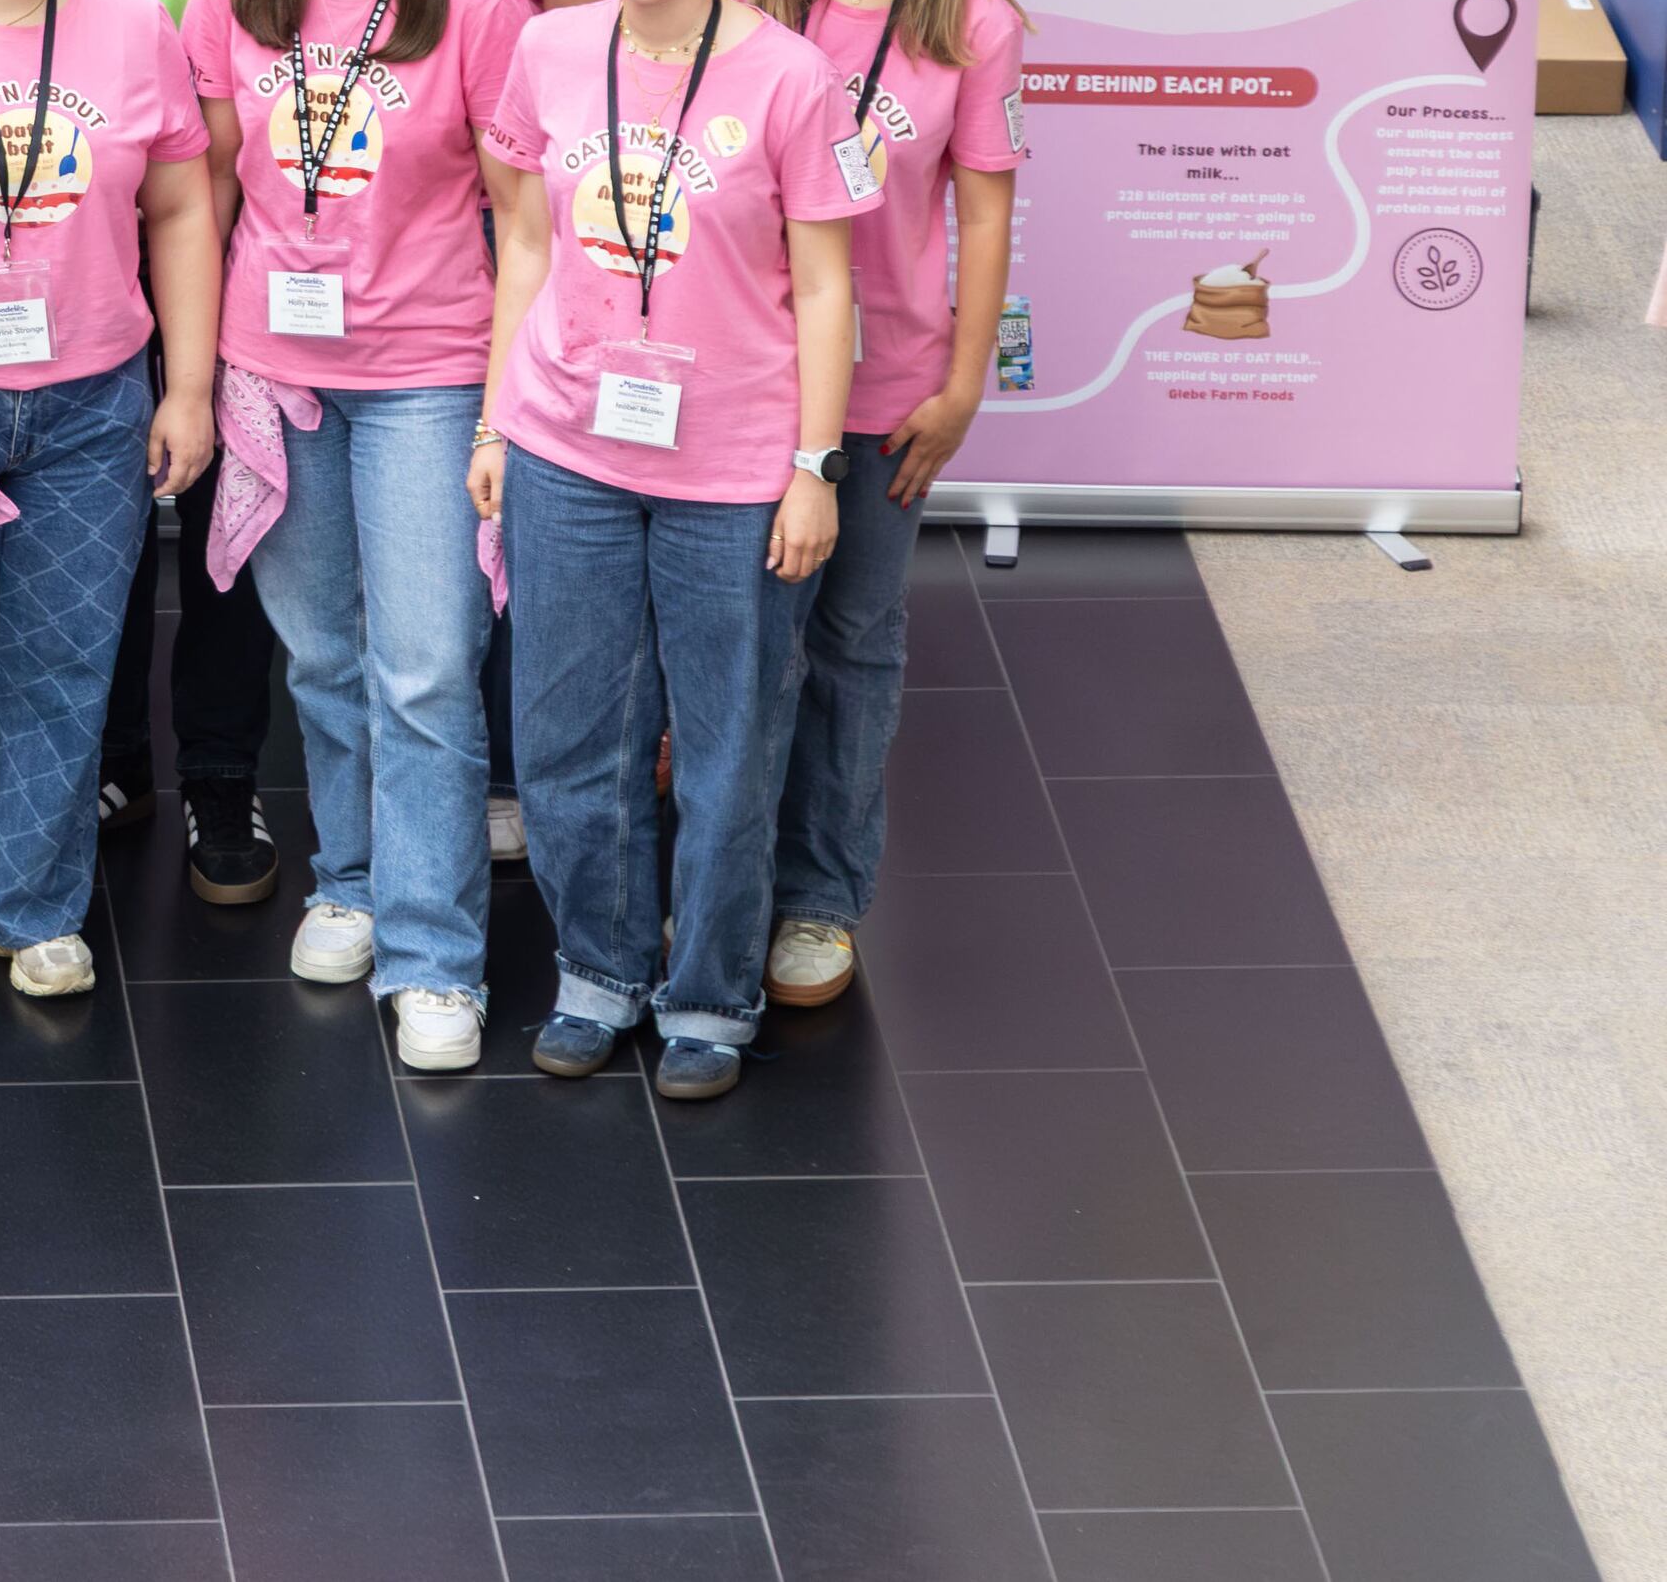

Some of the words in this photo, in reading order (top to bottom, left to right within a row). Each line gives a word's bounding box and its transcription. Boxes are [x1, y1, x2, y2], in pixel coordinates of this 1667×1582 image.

[1076, 75, 1158, 94] BEHIND
[1165, 76, 1224, 95] EACH
[1230, 77, 1293, 96] POT...
